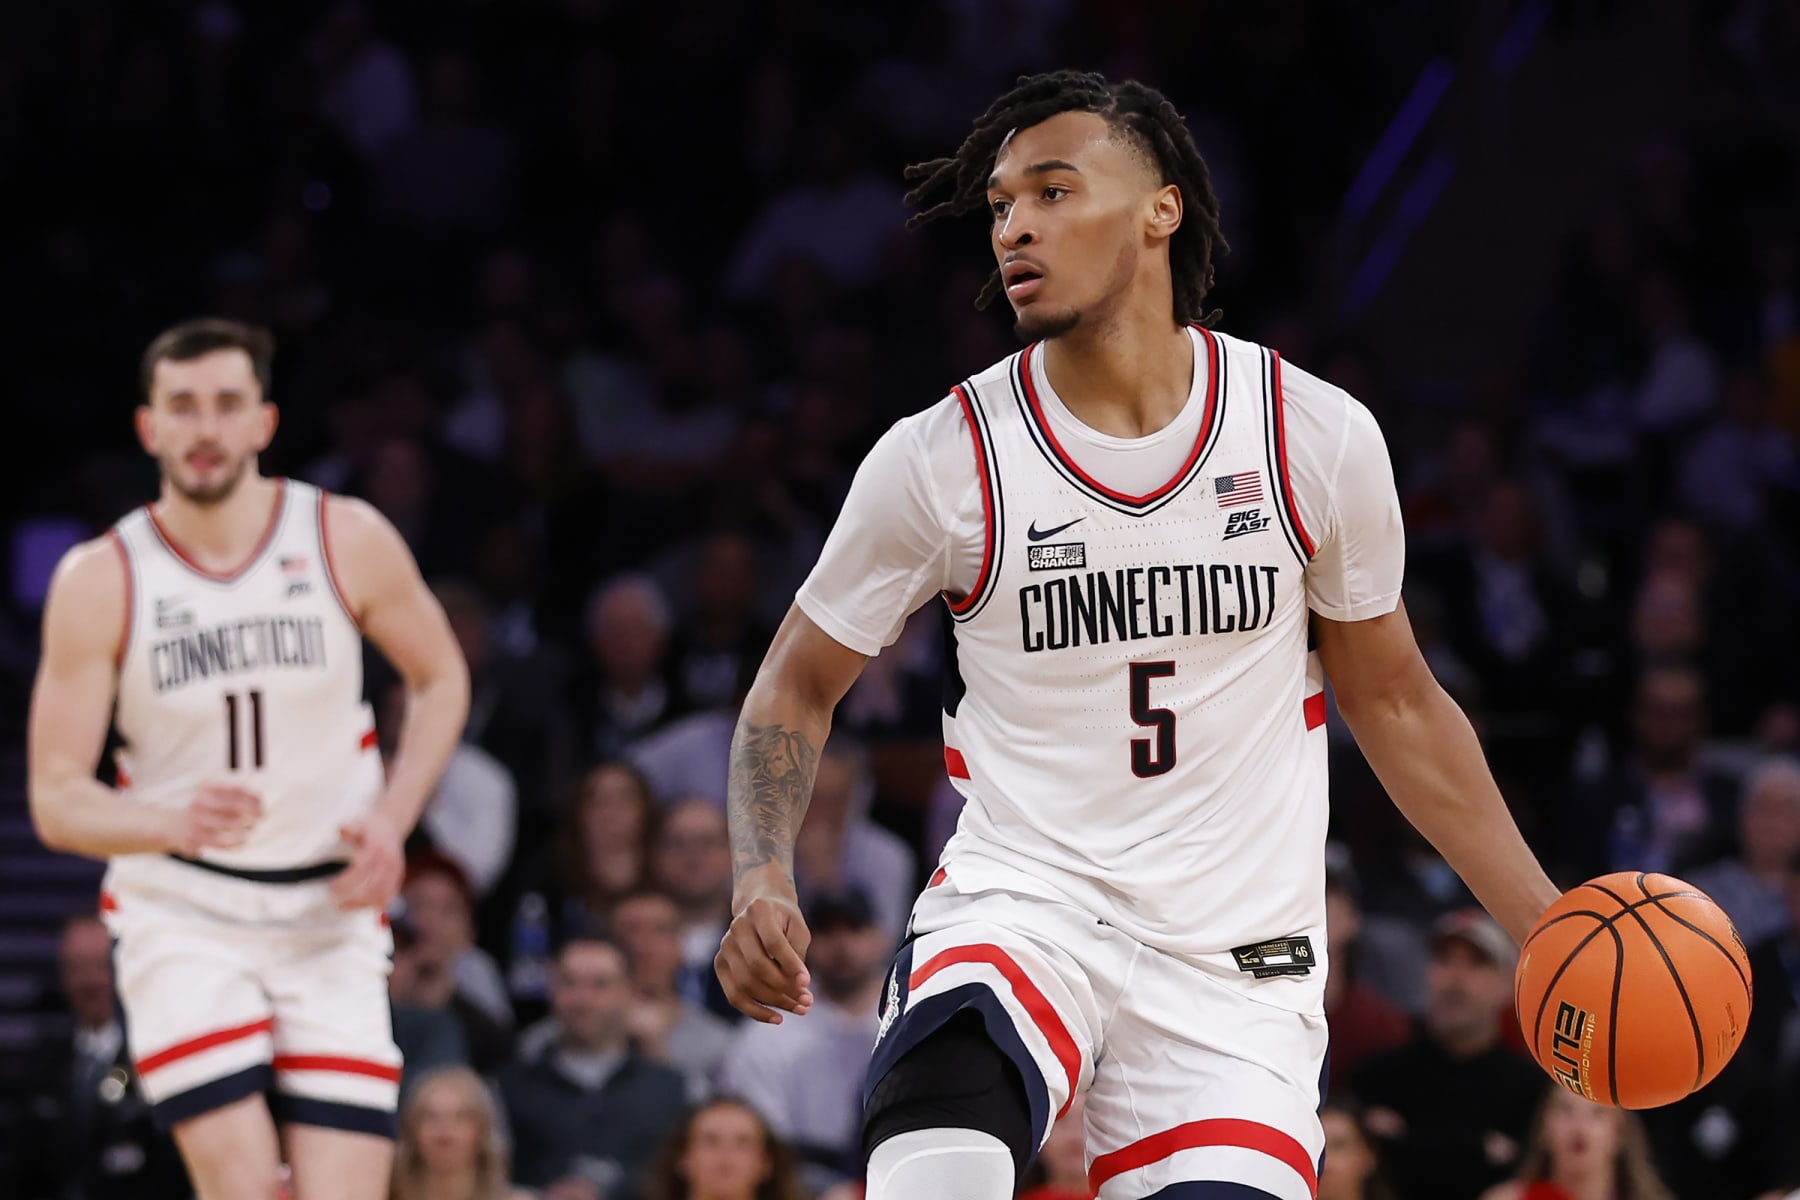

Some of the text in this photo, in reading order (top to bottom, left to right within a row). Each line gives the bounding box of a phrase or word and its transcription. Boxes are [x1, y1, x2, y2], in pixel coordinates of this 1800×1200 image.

[1224, 517, 1271, 534] EAST
[1228, 508, 1261, 524] BIG
[1031, 556, 1084, 568] CHANGE
[1019, 564, 1279, 653] CONNECTICUT
[150, 616, 327, 692] CONNECTICUT
[225, 688, 264, 771] 11
[1129, 661, 1176, 778] 5
[1295, 945, 1308, 958] 46
